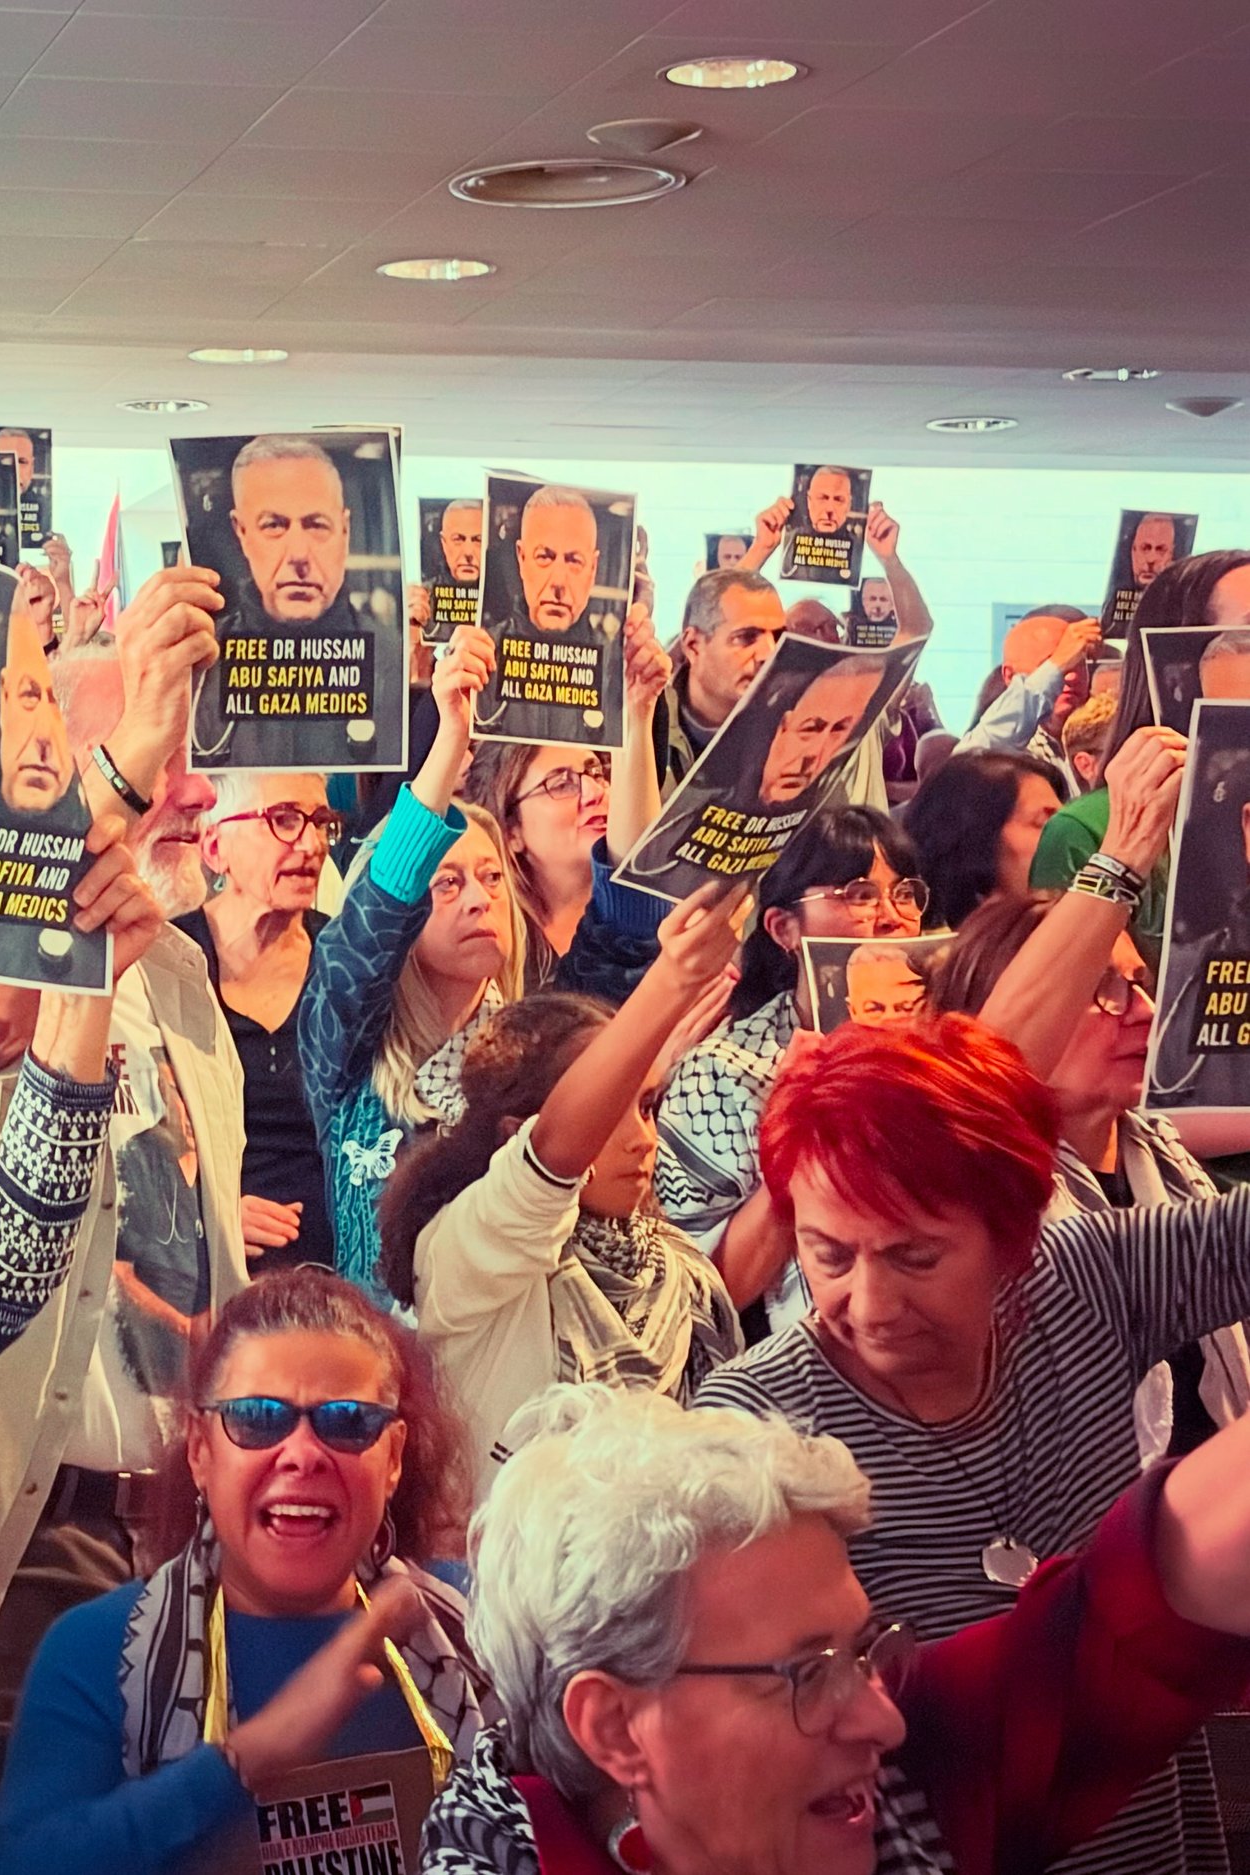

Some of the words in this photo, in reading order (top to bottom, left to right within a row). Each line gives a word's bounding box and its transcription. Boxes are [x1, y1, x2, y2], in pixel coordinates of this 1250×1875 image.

[225, 639, 267, 660] FREE
[272, 639, 295, 660] DR
[300, 638, 365, 660] HUSSAM
[503, 638, 531, 658] FREE
[534, 642, 549, 660] DR
[552, 644, 598, 666] HUSSAM
[228, 666, 262, 688] ABU
[267, 666, 324, 688] SAFIYA
[328, 666, 361, 687] AND
[504, 660, 527, 678] ABU
[530, 662, 568, 683] SAFIYA
[571, 667, 594, 686] AND
[225, 693, 254, 715] ALL
[259, 693, 300, 715] GAZA
[305, 692, 367, 715] MEDICS
[501, 680, 521, 698] ALL
[524, 682, 552, 702] GAZA
[555, 686, 598, 707] MEDICS
[702, 805, 746, 831] FREE
[743, 816, 767, 834] DR
[19, 832, 85, 862] HUSSAM
[691, 826, 728, 848] ABU
[675, 842, 706, 864] ALL
[34, 866, 70, 891] AND
[3, 892, 68, 923] MEDICS
[1204, 992, 1248, 1015] ABU
[1196, 1023, 1231, 1046] ALL
[256, 1791, 352, 1843] FREE
